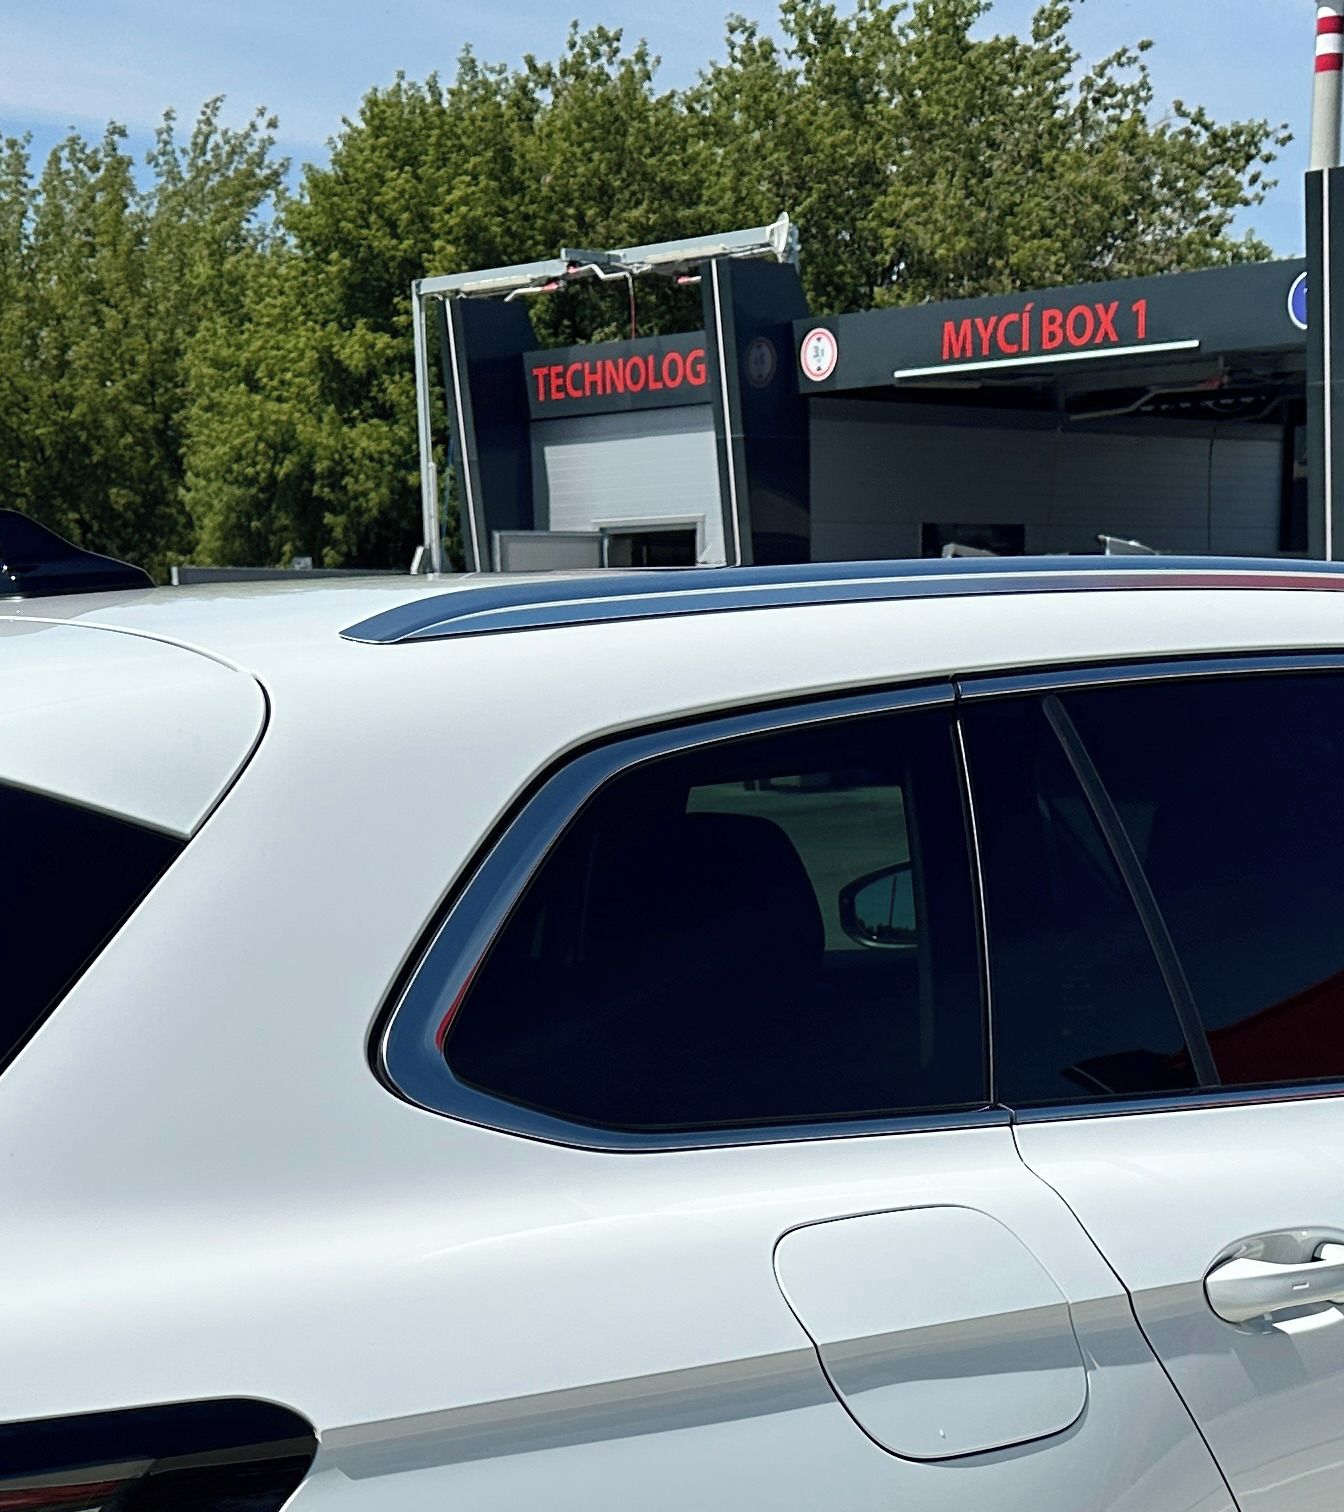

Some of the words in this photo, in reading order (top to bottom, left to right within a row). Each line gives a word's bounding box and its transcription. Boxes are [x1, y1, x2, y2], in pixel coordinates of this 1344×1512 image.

[941, 304, 1033, 360] MYCÍ
[1042, 302, 1119, 350] BOX
[1132, 299, 1147, 339] 1
[532, 348, 707, 401] TECHNOLOG
